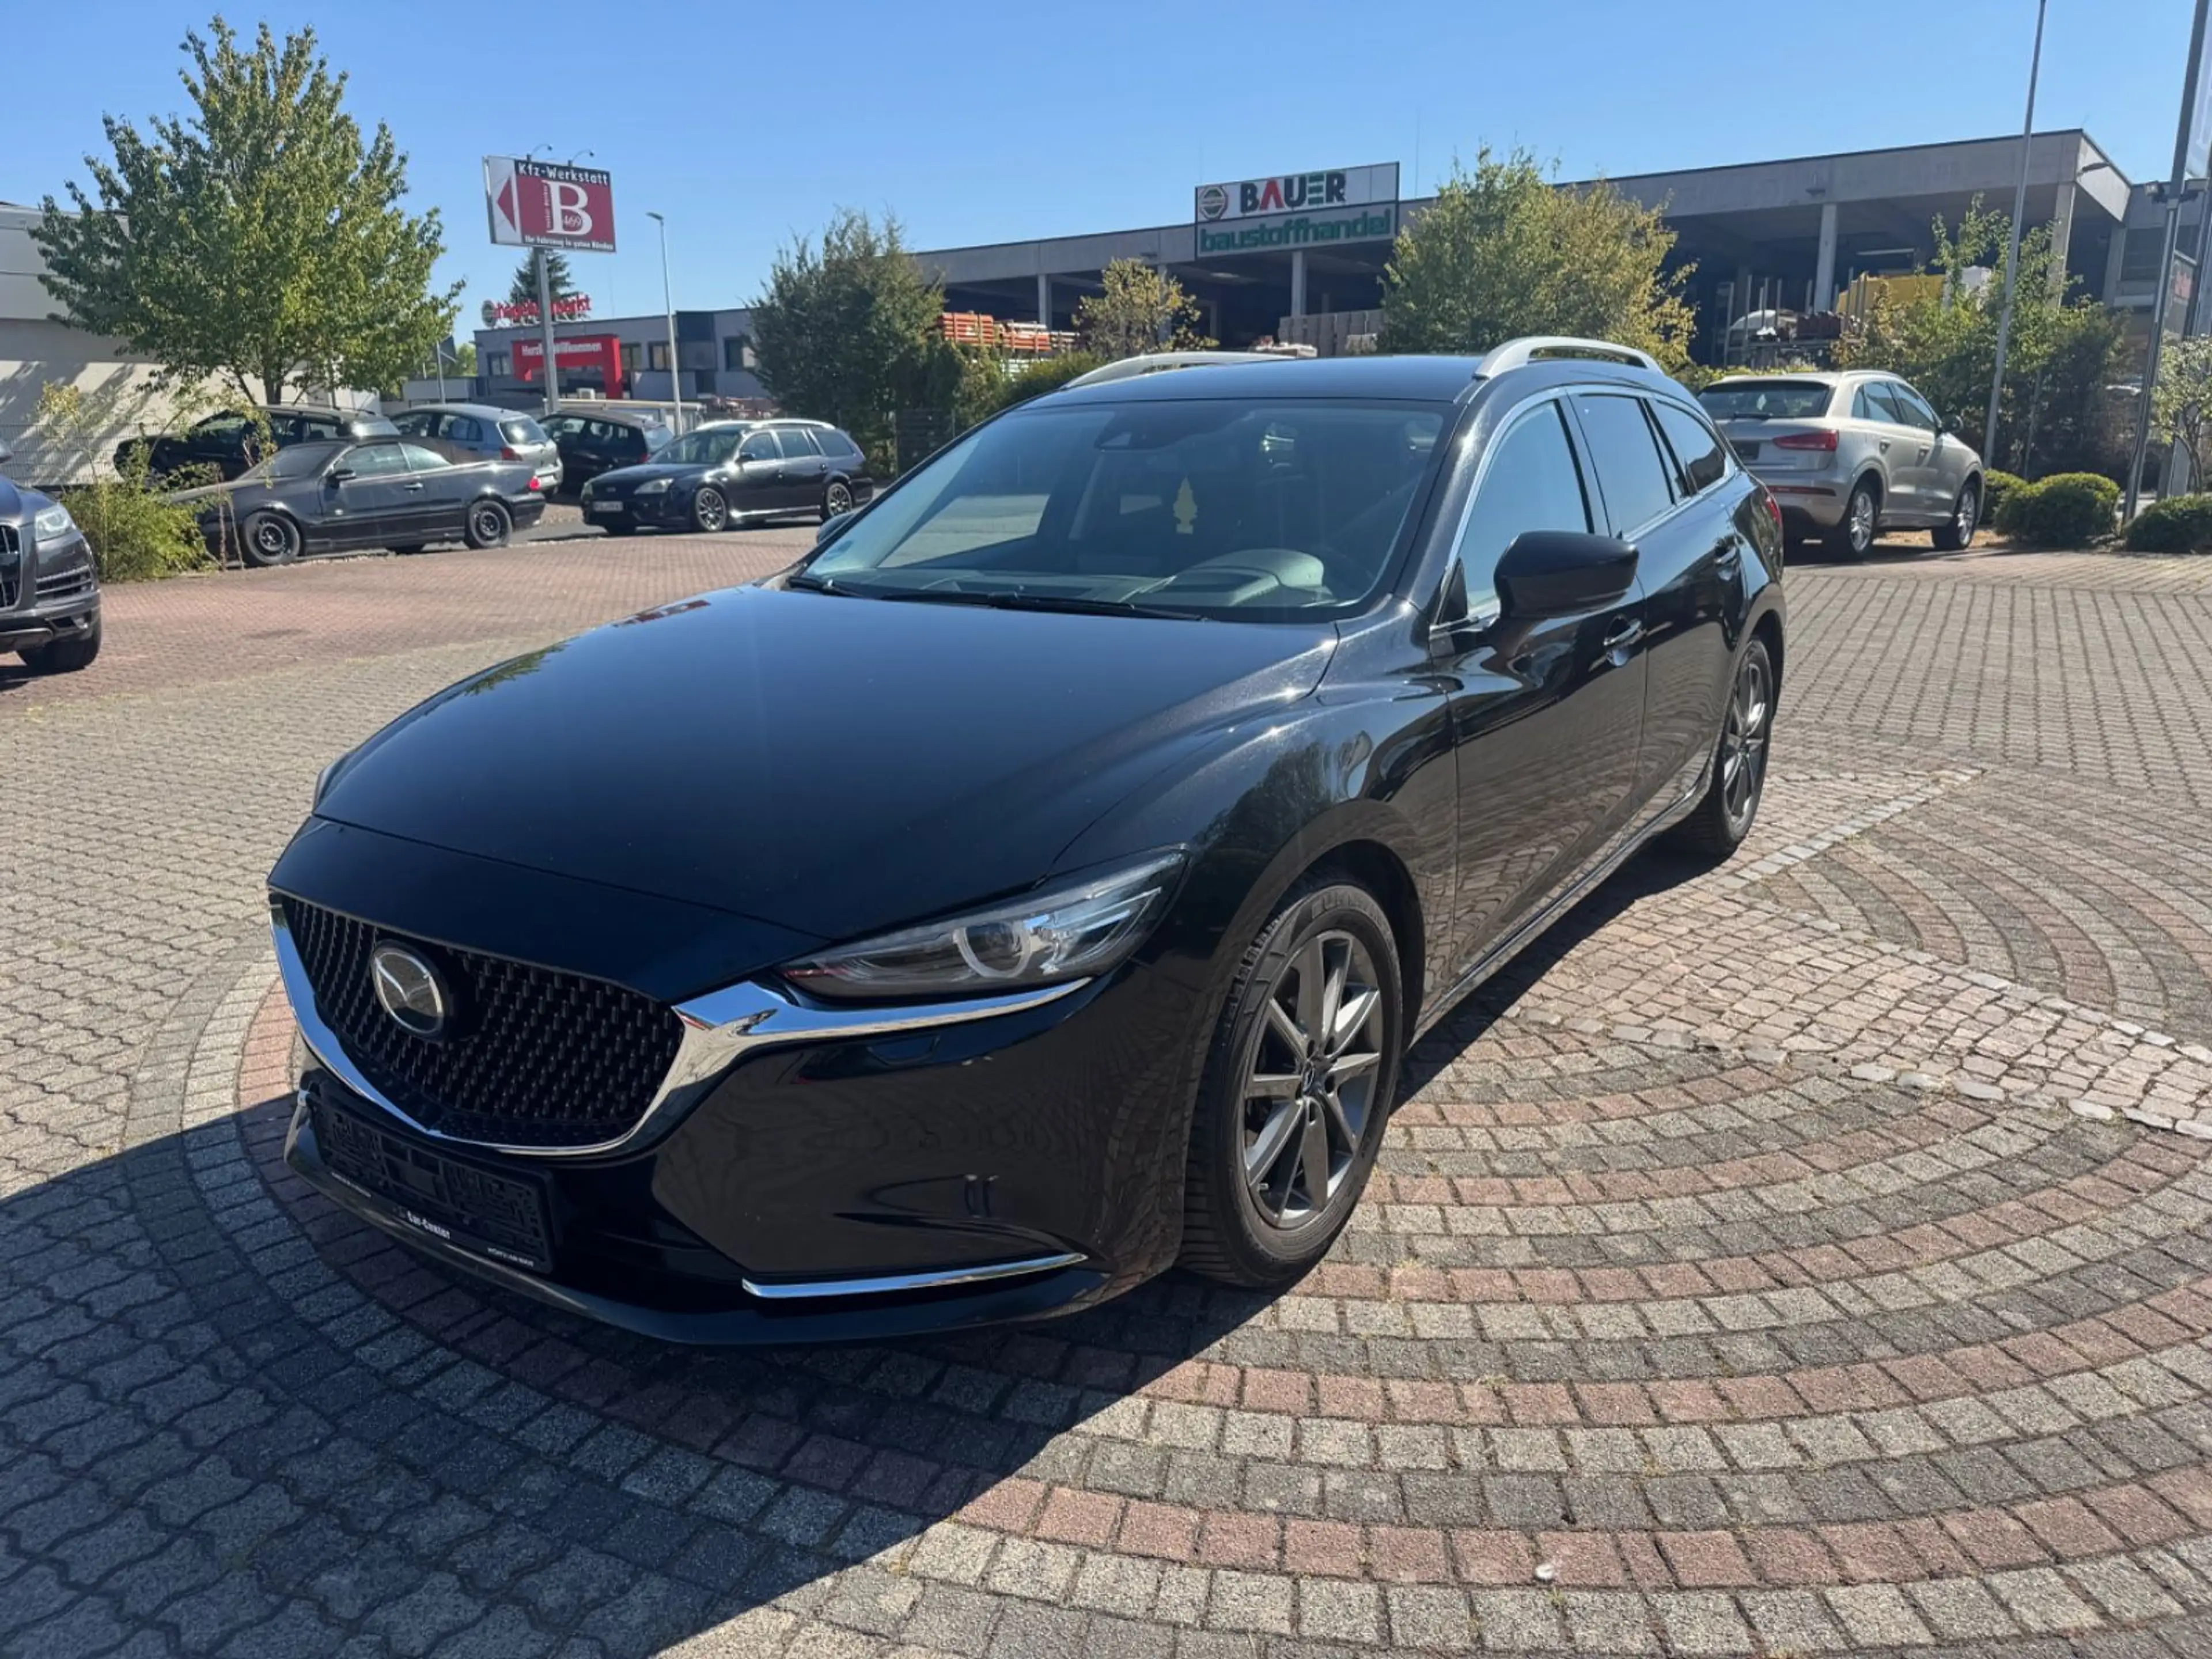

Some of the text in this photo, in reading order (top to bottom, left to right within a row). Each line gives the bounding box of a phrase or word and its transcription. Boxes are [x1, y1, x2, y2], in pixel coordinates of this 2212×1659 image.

[518, 162, 608, 185] Kfz-Werkstatt
[1240, 172, 1346, 213] BAUER
[541, 179, 593, 235] B
[1200, 208, 1391, 252] baustoffhandel
